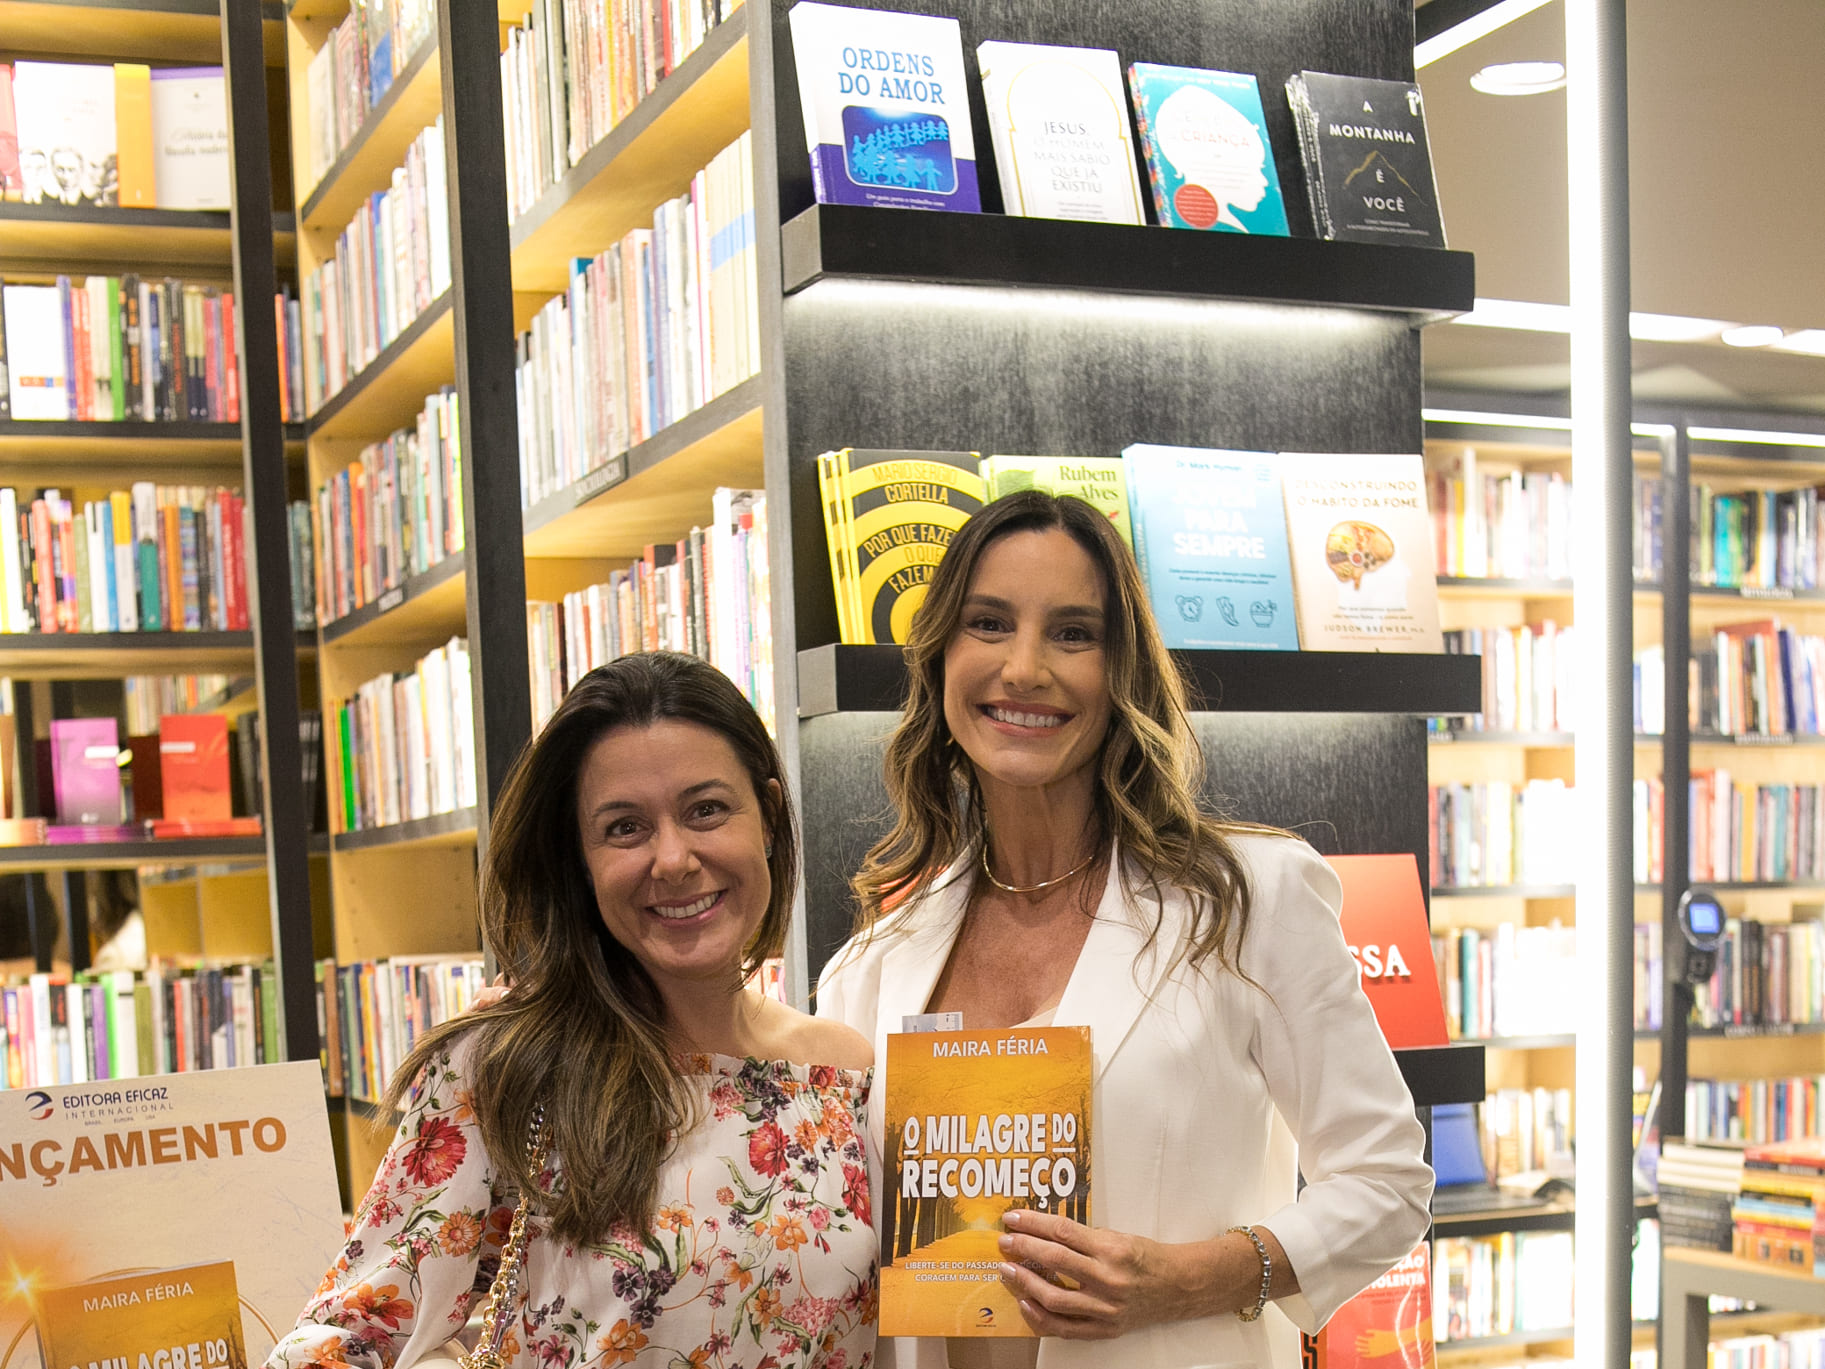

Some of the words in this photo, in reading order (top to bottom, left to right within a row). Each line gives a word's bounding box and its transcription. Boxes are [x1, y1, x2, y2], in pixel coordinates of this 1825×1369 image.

[842, 46, 935, 77] ORDENS
[838, 72, 870, 96] DO
[879, 77, 945, 104] AMOR
[1362, 100, 1374, 113] A
[1329, 123, 1416, 144] MONTANHA
[1052, 179, 1102, 194] EXISTIU
[1362, 196, 1406, 213] VOCÊ
[1059, 465, 1117, 482] Rubem
[884, 484, 949, 505] CORTELLA
[1081, 484, 1119, 500] Alves
[1362, 497, 1380, 508] DA
[1384, 497, 1418, 509] FOME
[863, 531, 895, 559] POR
[890, 524, 918, 545] QUE
[1172, 532, 1267, 560] SEMPRE
[903, 546, 915, 564] O
[933, 1038, 992, 1058] MAIRA
[996, 1035, 1049, 1055] FÉRIA
[62, 1093, 122, 1109] EDITORA
[126, 1087, 169, 1103] EFICAZ
[65, 1103, 175, 1121] INTERNACIONAL
[904, 1116, 920, 1149] O
[926, 1113, 1046, 1154] MILAGRE
[1052, 1112, 1077, 1143] DO
[0, 1117, 287, 1187] NÇAMENTO
[902, 1157, 1077, 1209] RECOMEÇO
[905, 1261, 950, 1270] LIBERTE-SE
[951, 1261, 964, 1270] DO
[915, 1273, 957, 1282] CORAGEM
[959, 1273, 980, 1282] PARA
[982, 1273, 998, 1282] SER
[83, 1290, 141, 1313] MAIRA
[145, 1282, 194, 1303] FÉRIA
[205, 1338, 229, 1364] DO
